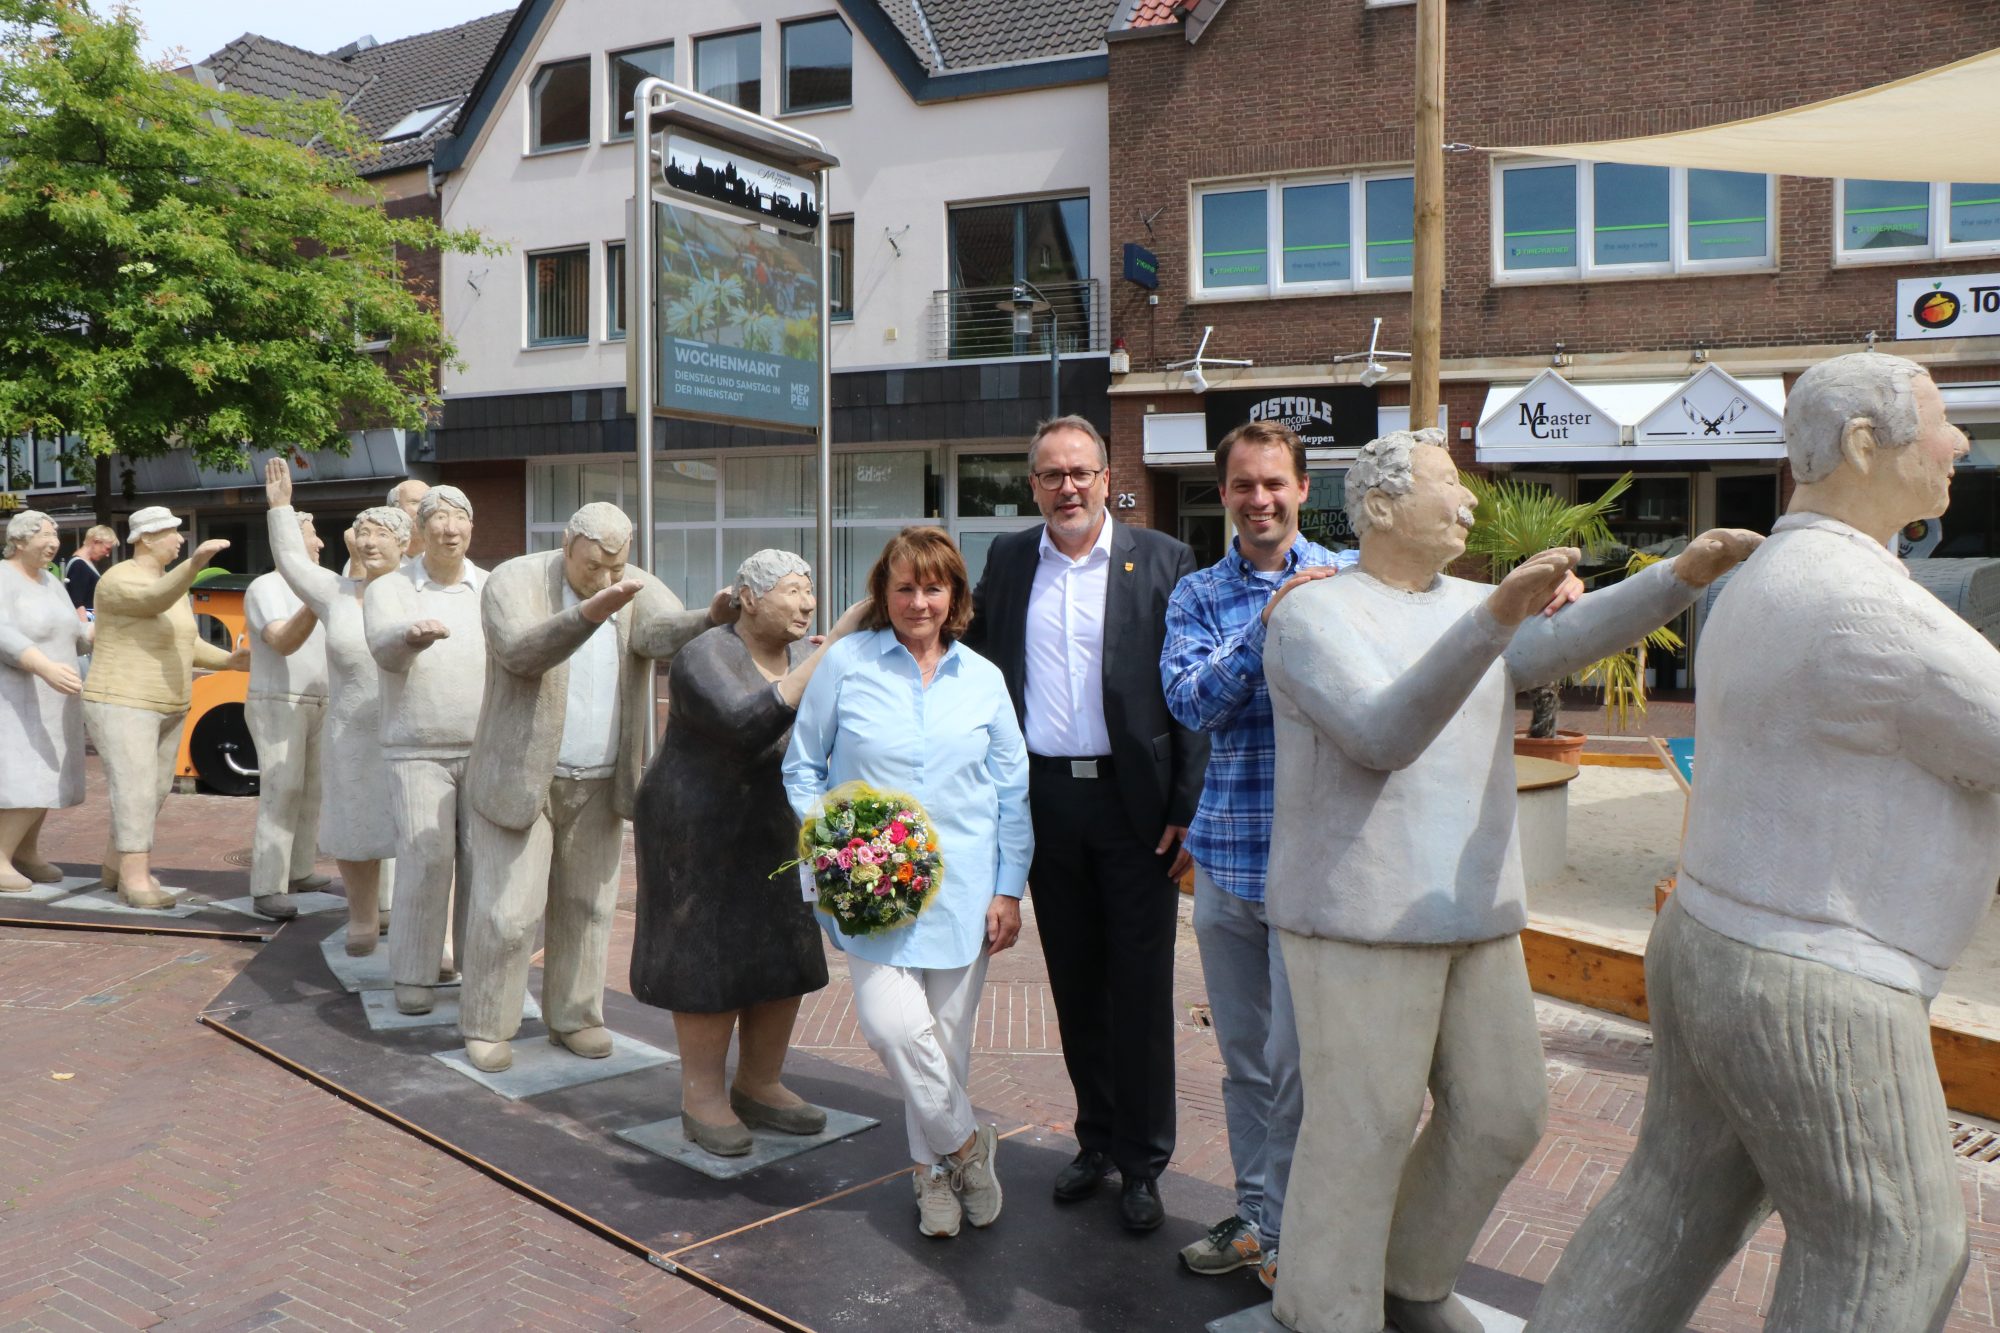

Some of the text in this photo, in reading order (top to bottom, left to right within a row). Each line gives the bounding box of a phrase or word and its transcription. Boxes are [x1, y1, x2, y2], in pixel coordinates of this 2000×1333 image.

[675, 346, 781, 378] WOCHENMARKT
[675, 370, 781, 395] DIENSTAG UND SAMSTAG IN
[791, 383, 810, 396] MEP
[675, 383, 744, 402] DER INNENSTADT
[791, 394, 809, 407] PEN
[1249, 397, 1333, 424] PISTOLE
[1518, 402, 1592, 426] Master
[1531, 415, 1569, 439] Cut
[1299, 435, 1335, 445] Meppen
[1118, 493, 1136, 508] 25
[1301, 511, 1346, 527] HARDC
